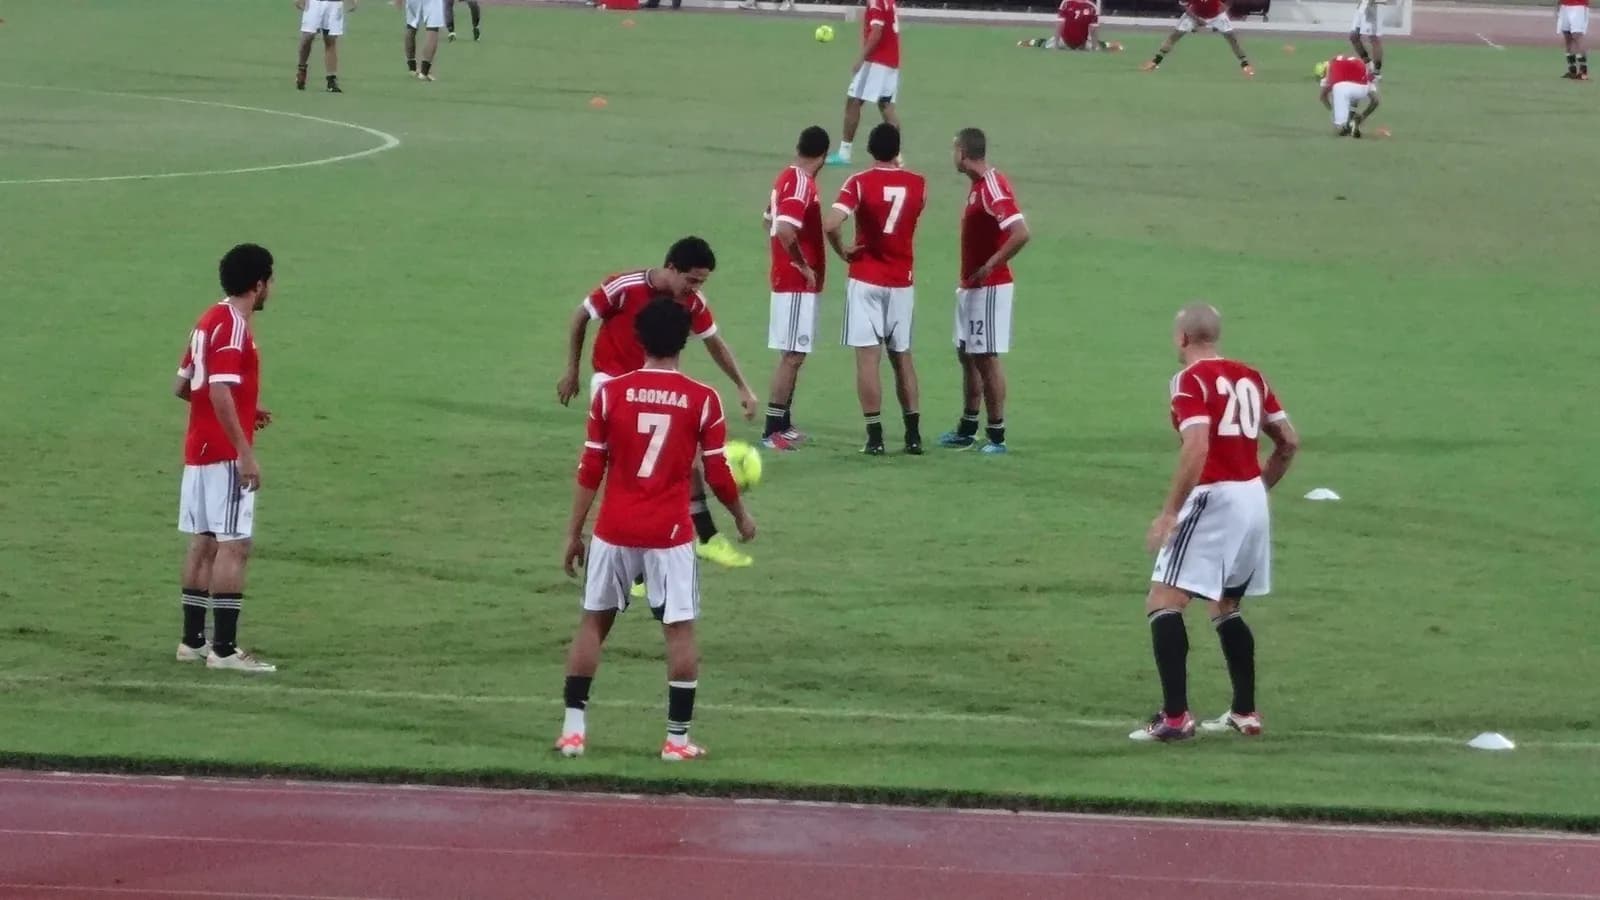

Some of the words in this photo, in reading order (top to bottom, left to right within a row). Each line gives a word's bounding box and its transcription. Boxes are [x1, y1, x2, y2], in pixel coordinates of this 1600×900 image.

[882, 186, 907, 235] 7
[969, 320, 984, 336] 12
[625, 387, 689, 409] S.GOMAA
[1215, 375, 1261, 439] 20
[636, 412, 671, 478] 7
